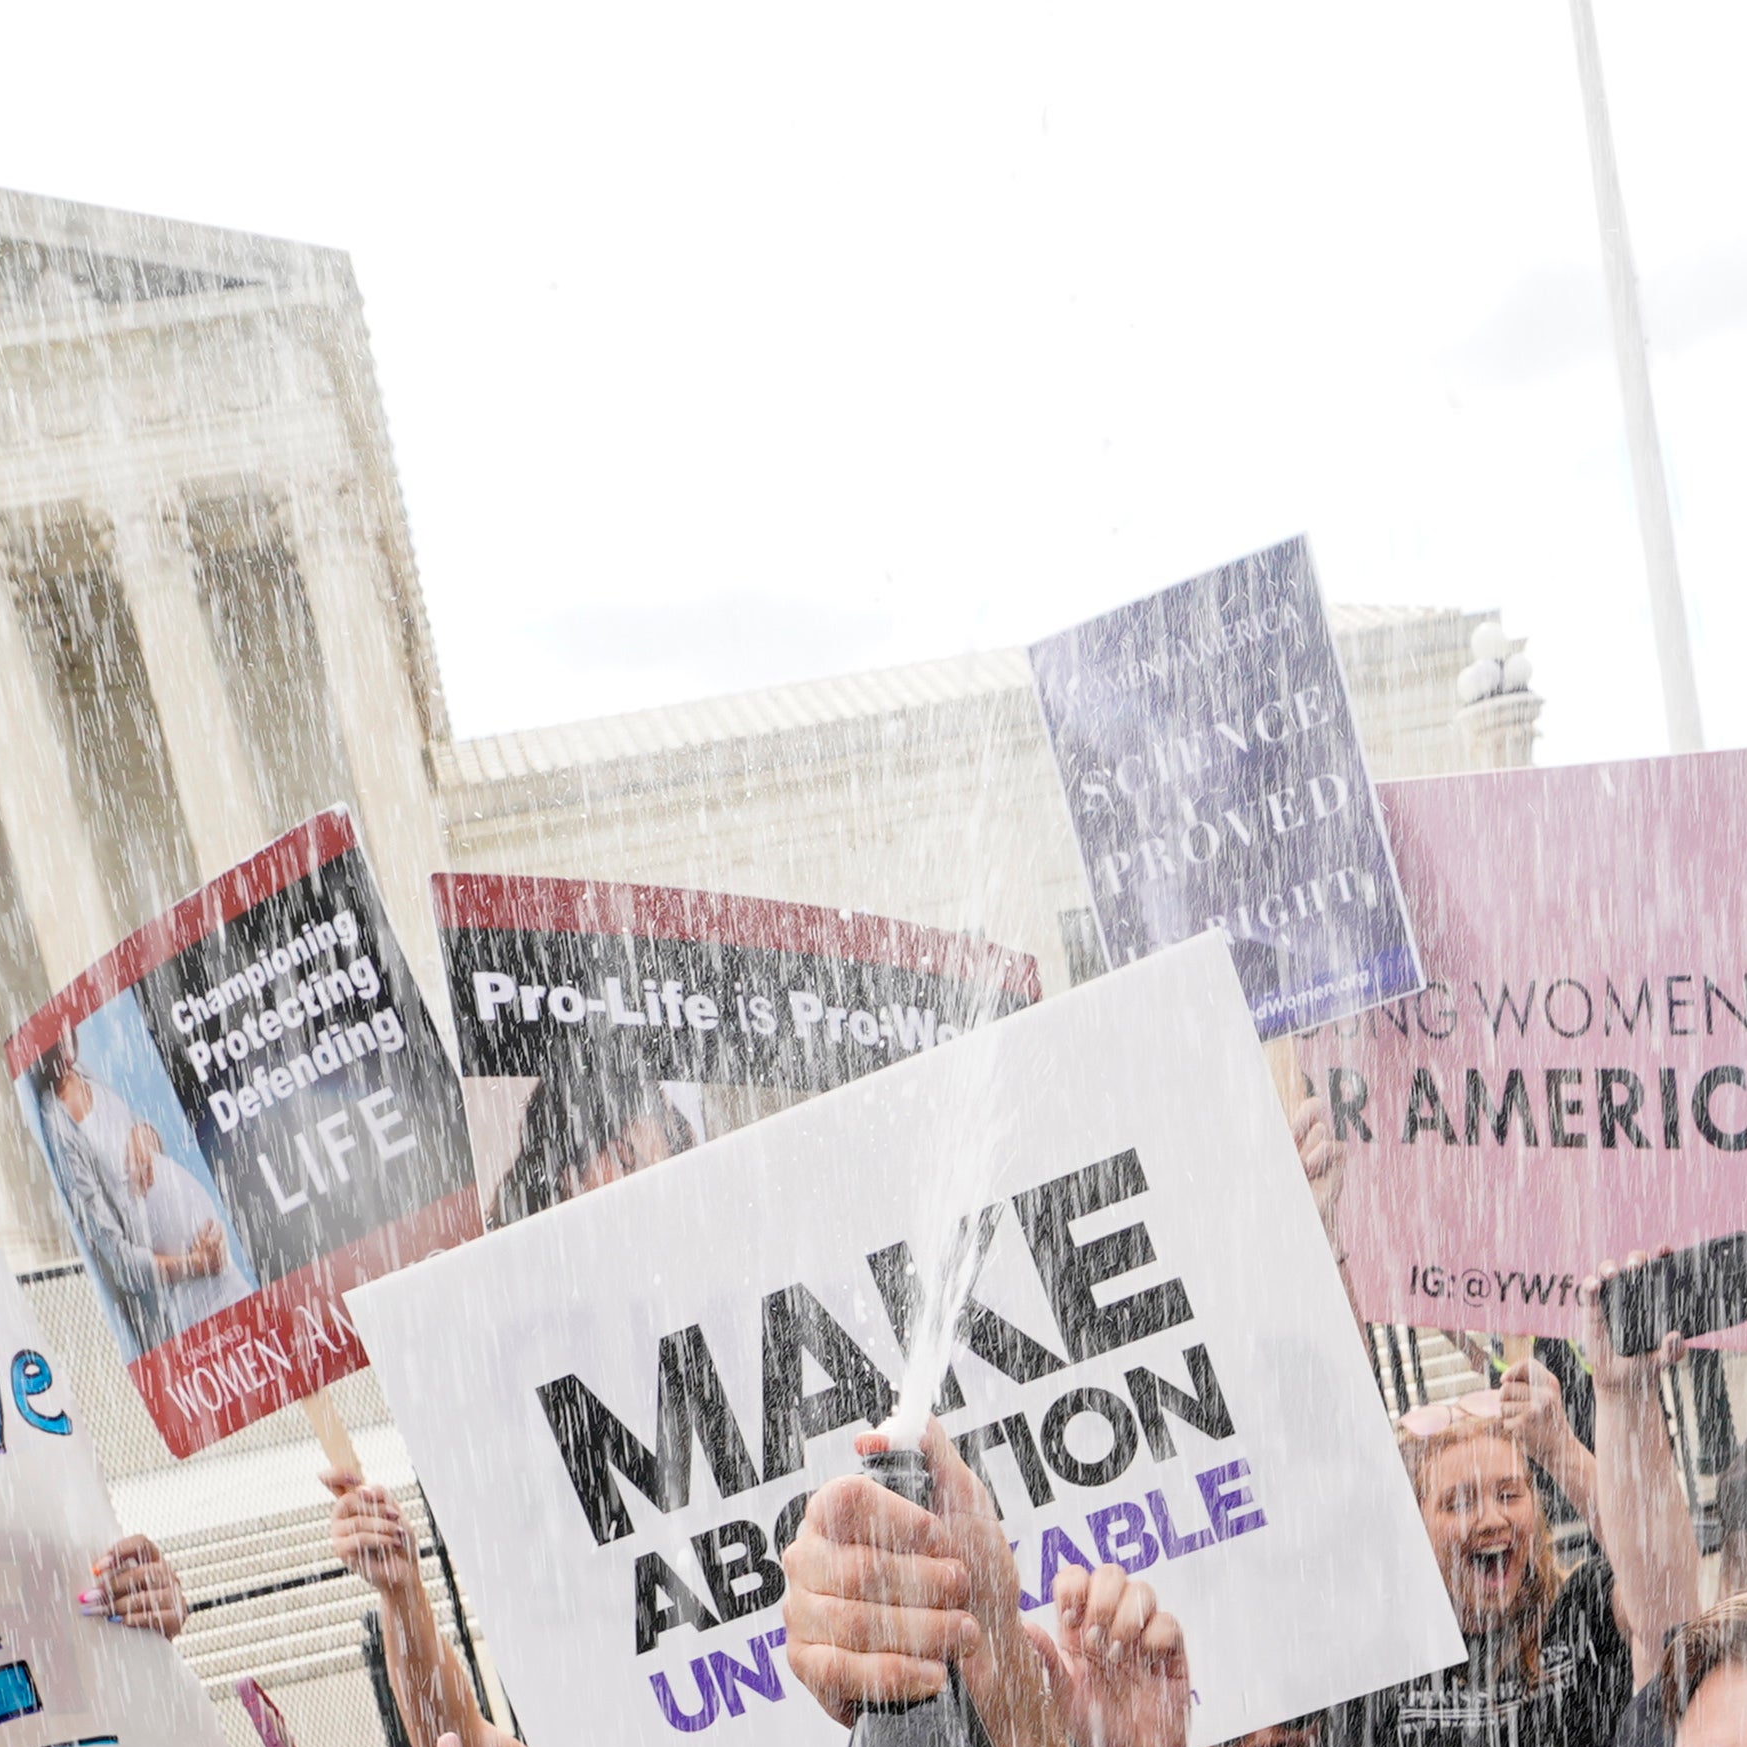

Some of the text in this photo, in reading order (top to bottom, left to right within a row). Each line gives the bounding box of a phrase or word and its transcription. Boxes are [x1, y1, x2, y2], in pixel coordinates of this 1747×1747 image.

[1080, 686, 1330, 818] SCIENCE
[1103, 773, 1350, 898] PROVED
[171, 909, 359, 1034] Championing
[186, 955, 382, 1083] Protecting
[472, 971, 720, 1031] Pro-Life
[734, 982, 778, 1037] is
[208, 1006, 406, 1134] Defending
[256, 1086, 419, 1215] LIFE
[164, 1328, 294, 1424] WOMEN
[534, 1148, 1194, 1547] MAKE
[635, 1342, 1236, 1656] ABTION
